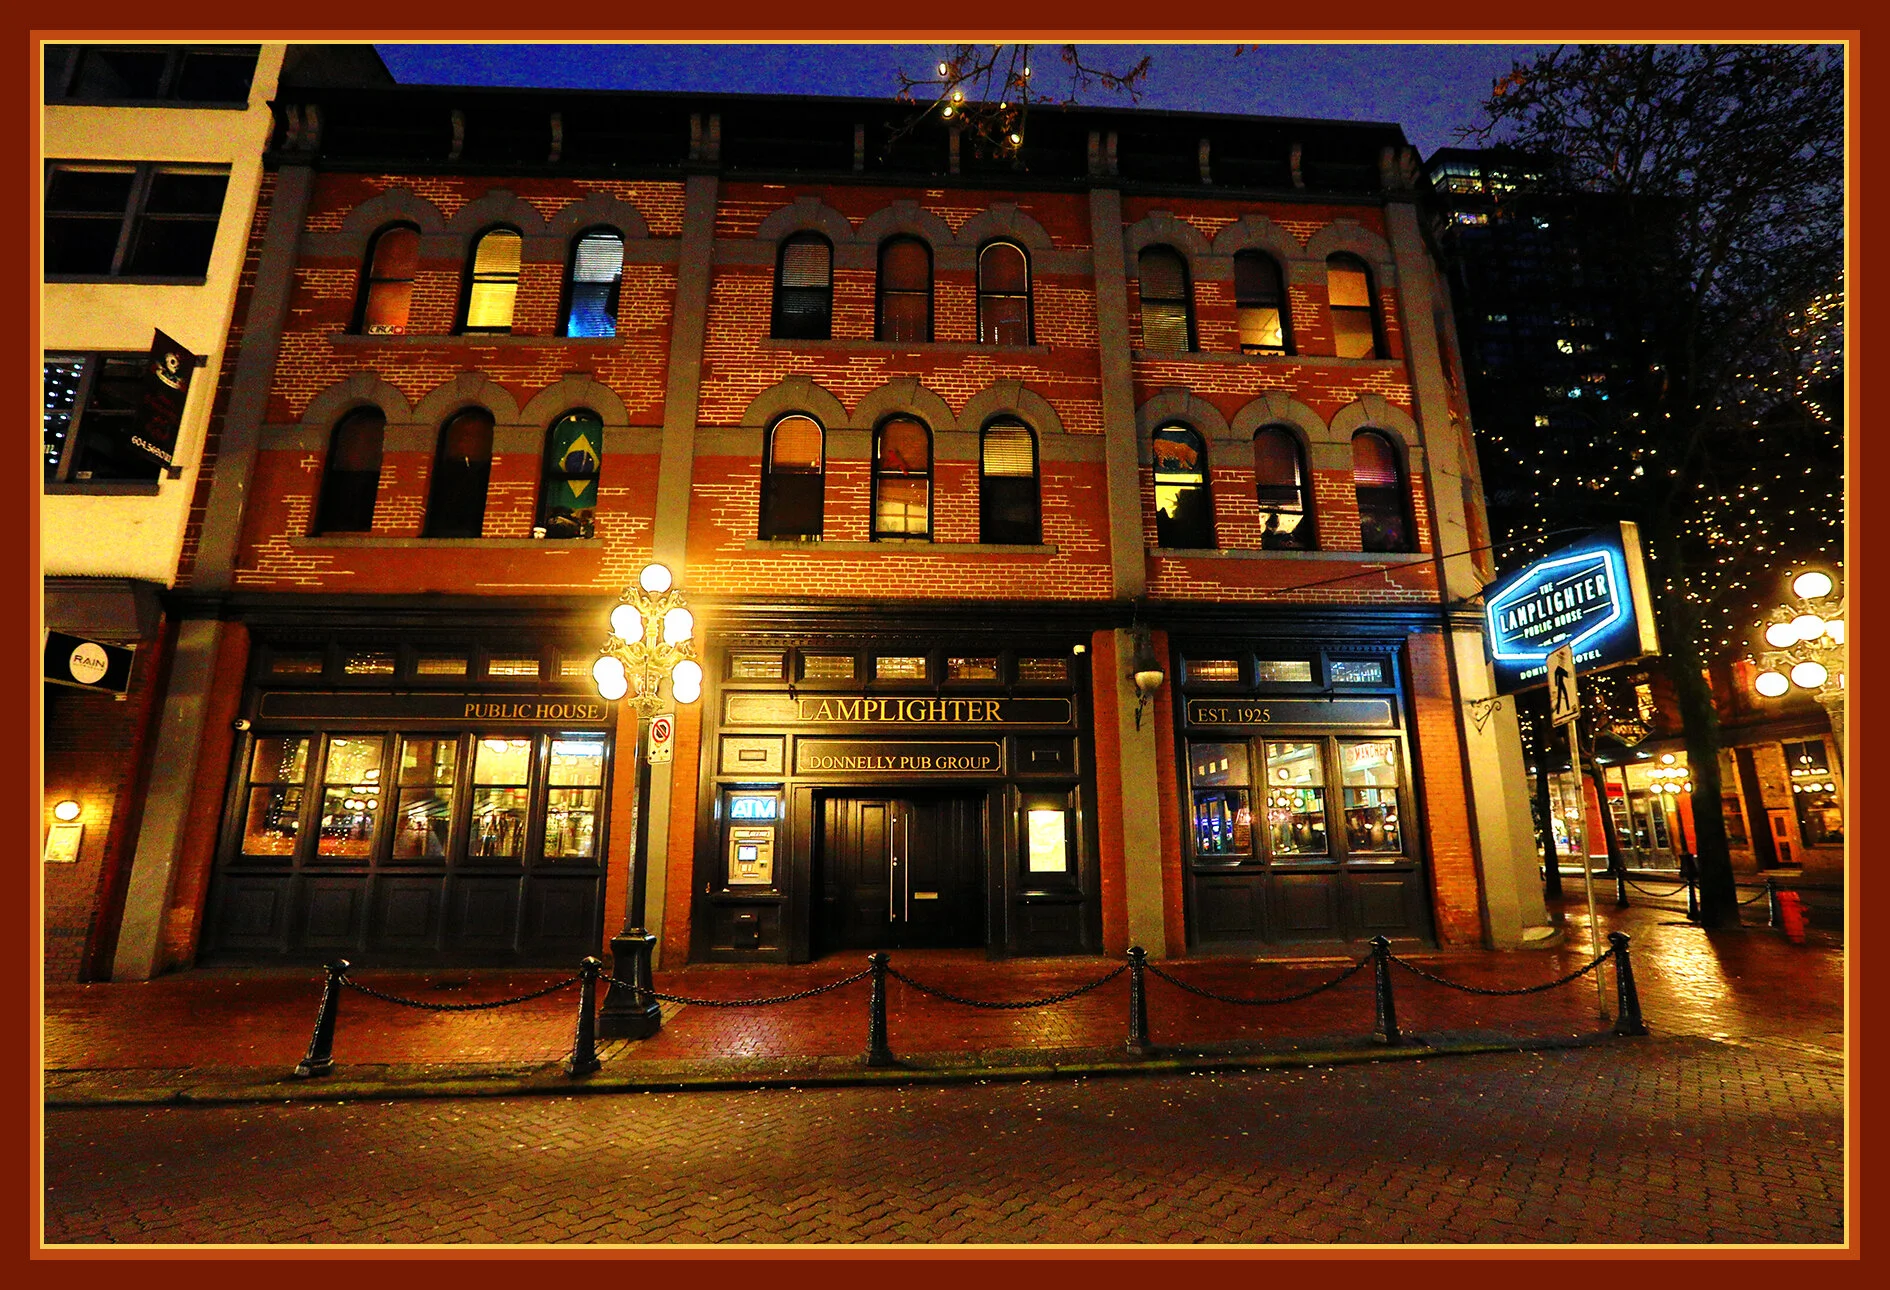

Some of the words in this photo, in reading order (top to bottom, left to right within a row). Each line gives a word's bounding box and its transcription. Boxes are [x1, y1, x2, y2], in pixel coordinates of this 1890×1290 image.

[1539, 582, 1554, 595] THE
[1499, 574, 1608, 633] LAMPLIGHTER
[1523, 620, 1553, 638] PUBLIC
[1555, 609, 1583, 628] HOUSE
[73, 655, 105, 668] RAIN
[464, 703, 532, 718] PUBLIC
[536, 704, 599, 719] HOUSE
[797, 699, 1004, 722] LAMPLIGHTER
[1198, 708, 1232, 722] EST.
[1238, 708, 1271, 723] 1925
[810, 756, 896, 770] DONNELLY
[900, 757, 932, 769] PUB
[935, 757, 991, 770] GROUP
[731, 799, 776, 819] ATM
